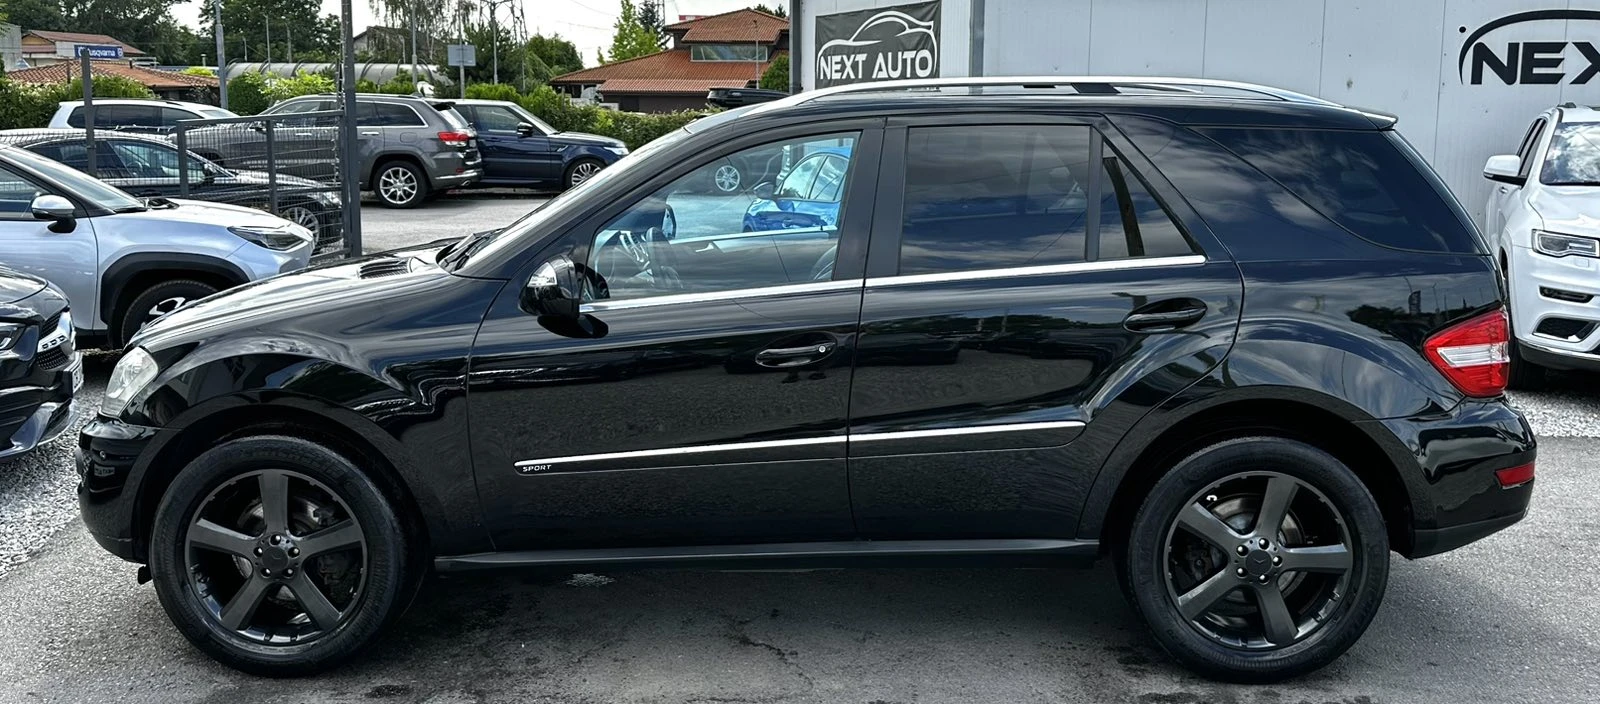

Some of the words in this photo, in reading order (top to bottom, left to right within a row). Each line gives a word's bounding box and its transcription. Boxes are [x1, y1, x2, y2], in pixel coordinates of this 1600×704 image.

[820, 53, 867, 80] NEXT
[872, 49, 933, 79] AUTO
[522, 464, 552, 472] SPORT
